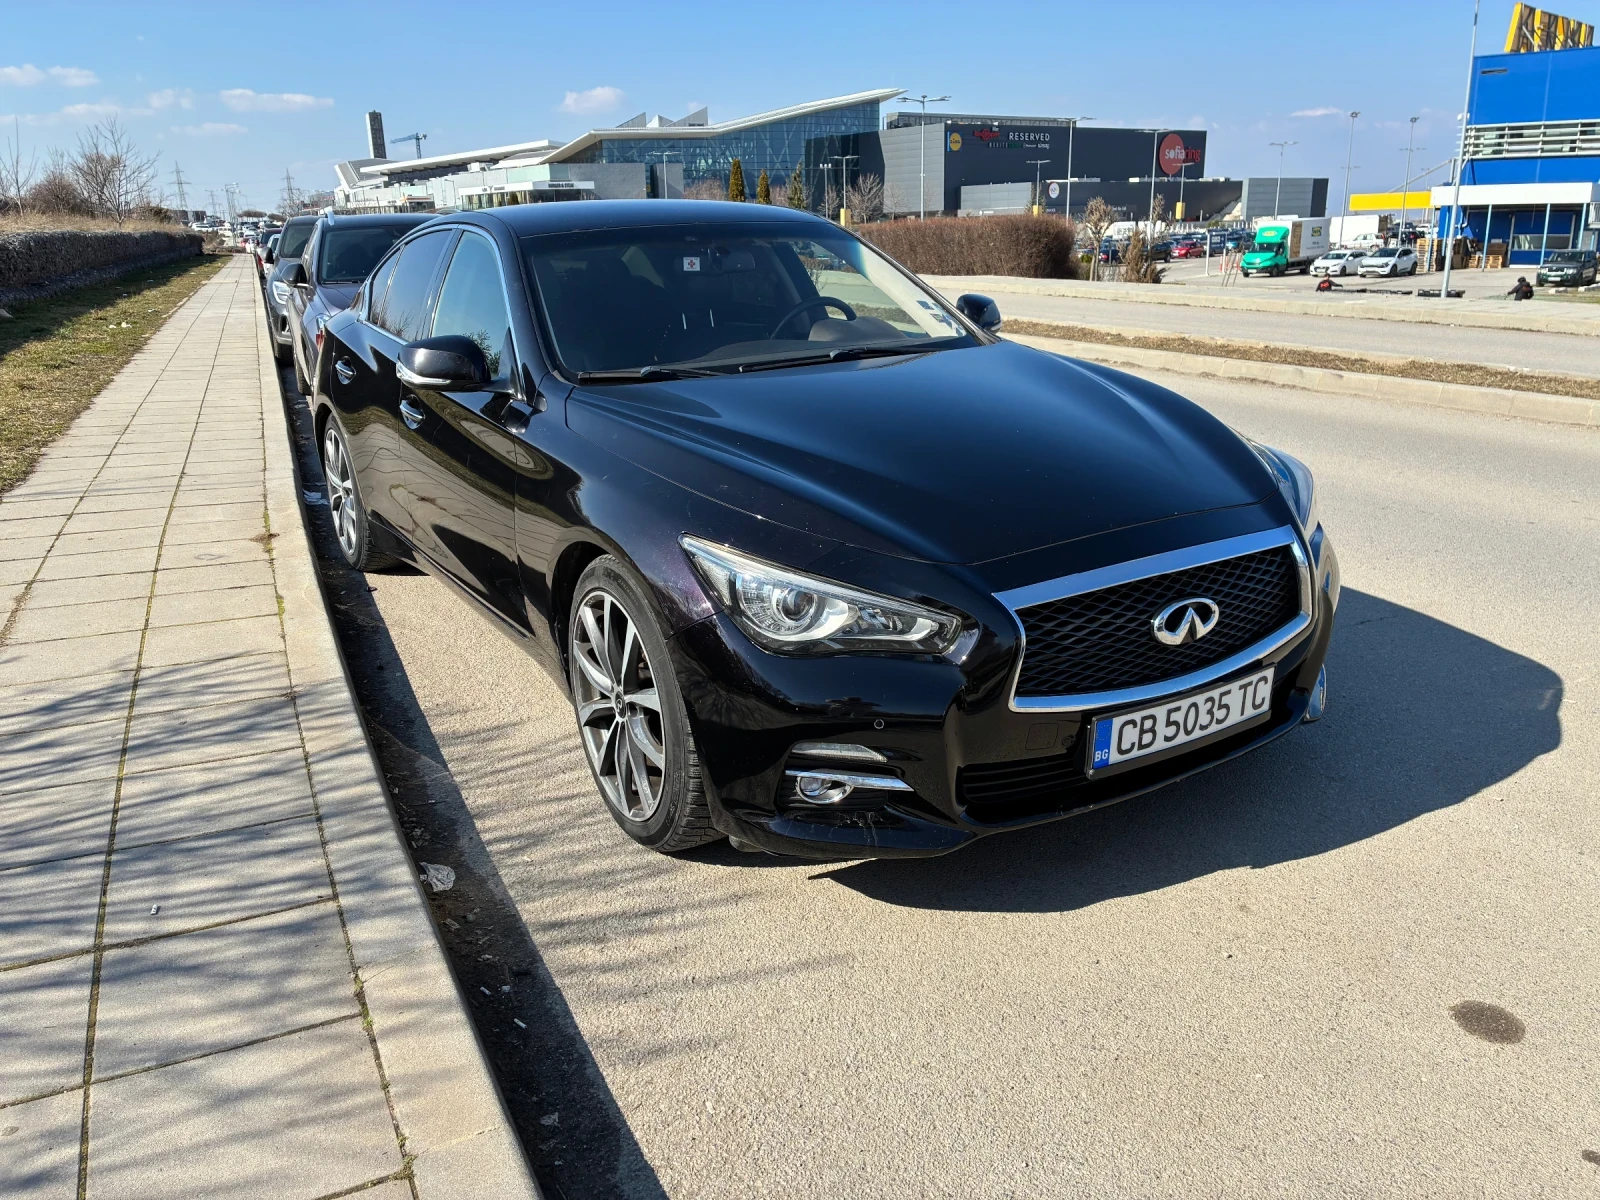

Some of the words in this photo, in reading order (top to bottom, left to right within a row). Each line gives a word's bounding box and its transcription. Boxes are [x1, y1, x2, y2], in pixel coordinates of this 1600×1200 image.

[1008, 132, 1050, 141] RESERVED
[1116, 714, 1158, 756] CB
[1163, 689, 1232, 743] 5035
[1239, 675, 1269, 717] TC
[1094, 749, 1109, 762] BG
